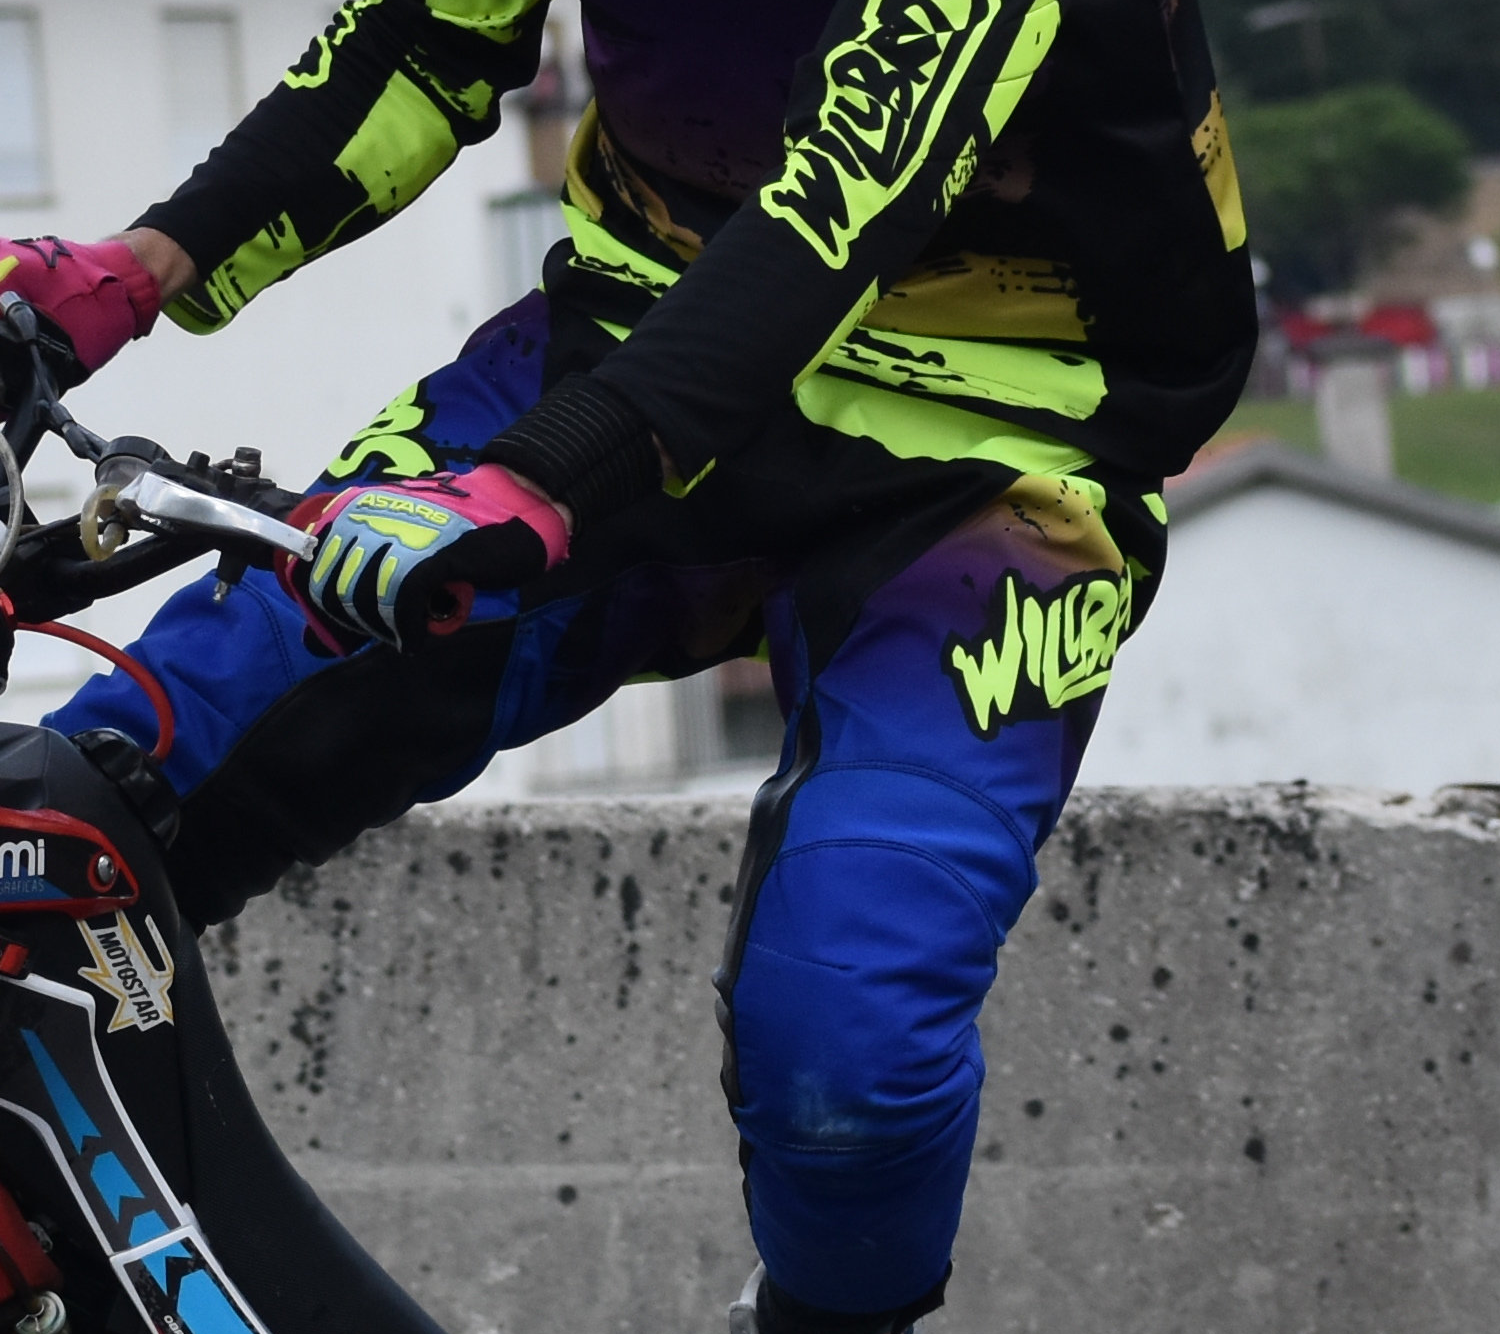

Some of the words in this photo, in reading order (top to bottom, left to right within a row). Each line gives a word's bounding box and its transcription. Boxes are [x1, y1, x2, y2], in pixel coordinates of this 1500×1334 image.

[357, 493, 450, 525] ASTARS
[952, 563, 1132, 731] WILLBR
[97, 931, 160, 1024] MOTOSTAR
